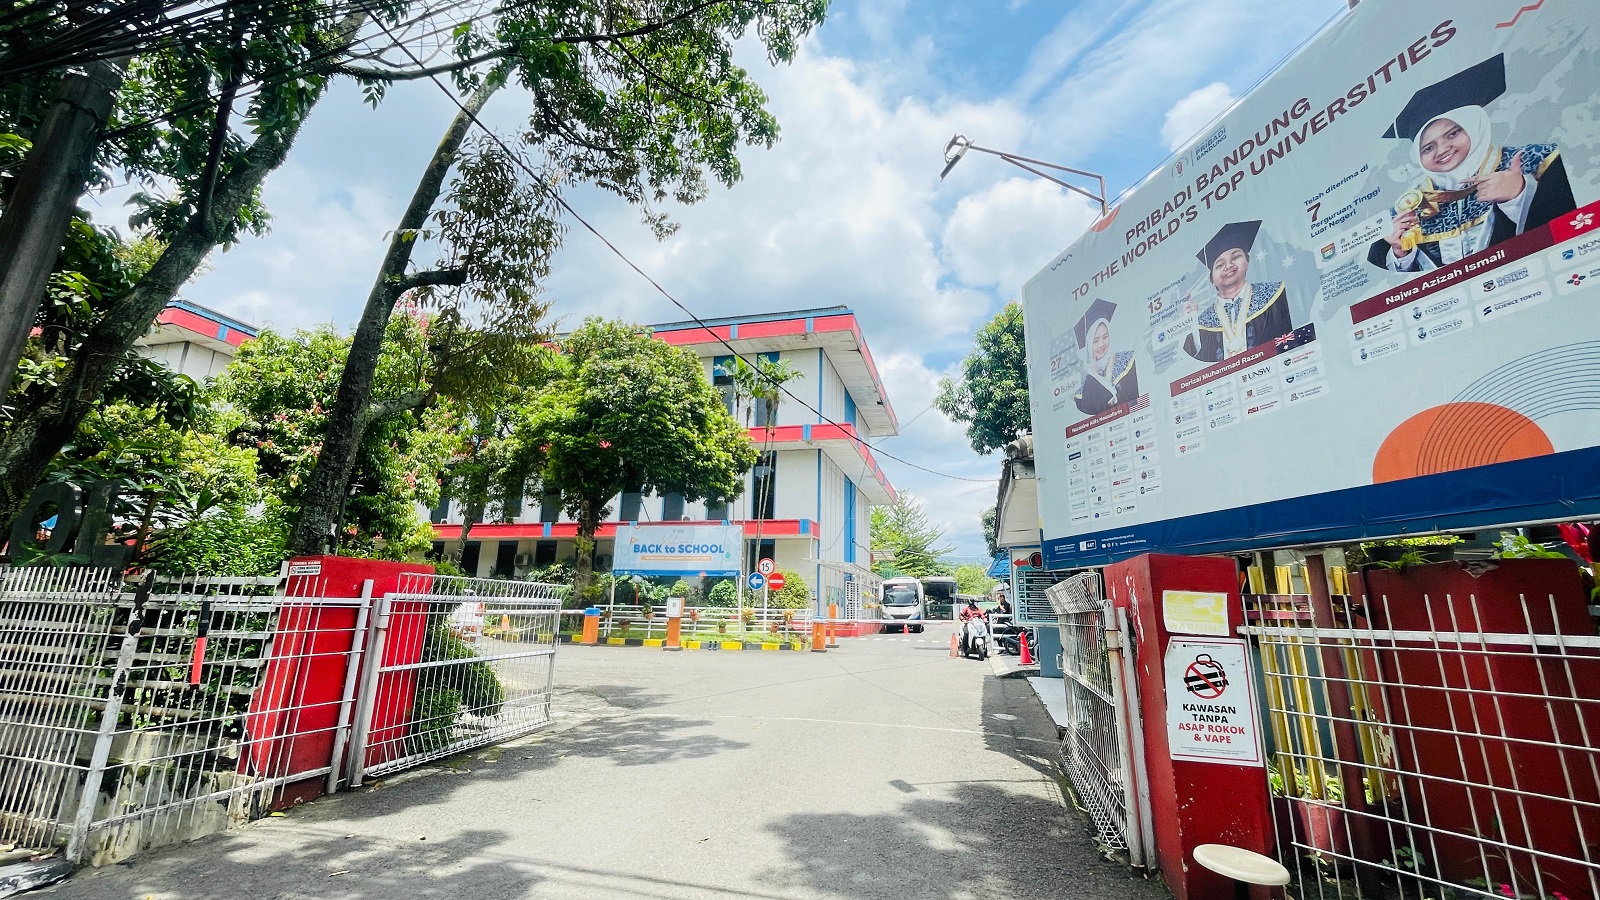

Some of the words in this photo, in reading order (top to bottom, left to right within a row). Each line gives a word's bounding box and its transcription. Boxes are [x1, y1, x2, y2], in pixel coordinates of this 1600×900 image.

[1195, 128, 1226, 156] PRIBADI
[1196, 136, 1227, 160] BANDUNG
[1072, 282, 1090, 301] TO
[1091, 260, 1120, 287] THE
[1121, 204, 1198, 268] WORLD'S
[1200, 170, 1245, 210] TOP
[1250, 19, 1457, 176] UNIVERSITIES
[1125, 185, 1192, 245] PRIBADI
[1196, 97, 1311, 193] BANDUNG
[1303, 192, 1324, 206] Telah
[1325, 171, 1359, 194] diterima
[1360, 164, 1369, 174] di
[1306, 201, 1321, 223] 7
[1310, 204, 1352, 230] Perguruan
[1353, 186, 1381, 206] Tinggi
[1310, 226, 1328, 238] Luar
[1329, 209, 1357, 229] Negeri
[1385, 286, 1420, 305] Najwa
[1422, 268, 1462, 291] Azizah
[1464, 249, 1506, 273] Ismail
[1148, 297, 1163, 314] 13
[1424, 299, 1459, 315] TORONTO
[1494, 299, 1519, 311] SCIENCE
[1520, 291, 1542, 302] TOKYO
[1429, 319, 1463, 335] TORONTO
[1050, 357, 1062, 373] 27
[1202, 360, 1241, 381] Muhammad
[1241, 351, 1264, 364] Razan
[1248, 366, 1271, 380] UNSW
[634, 544, 662, 553] BACK
[664, 544, 675, 553] to
[678, 544, 724, 554] SCHOOL
[761, 563, 770, 572] 15
[1182, 703, 1236, 714] KAWASAN
[1192, 713, 1229, 724] TANPA
[1178, 722, 1205, 732] ASAP
[1207, 724, 1246, 735] ROKOK
[1194, 733, 1202, 742] &
[1204, 733, 1232, 744] VAPE
